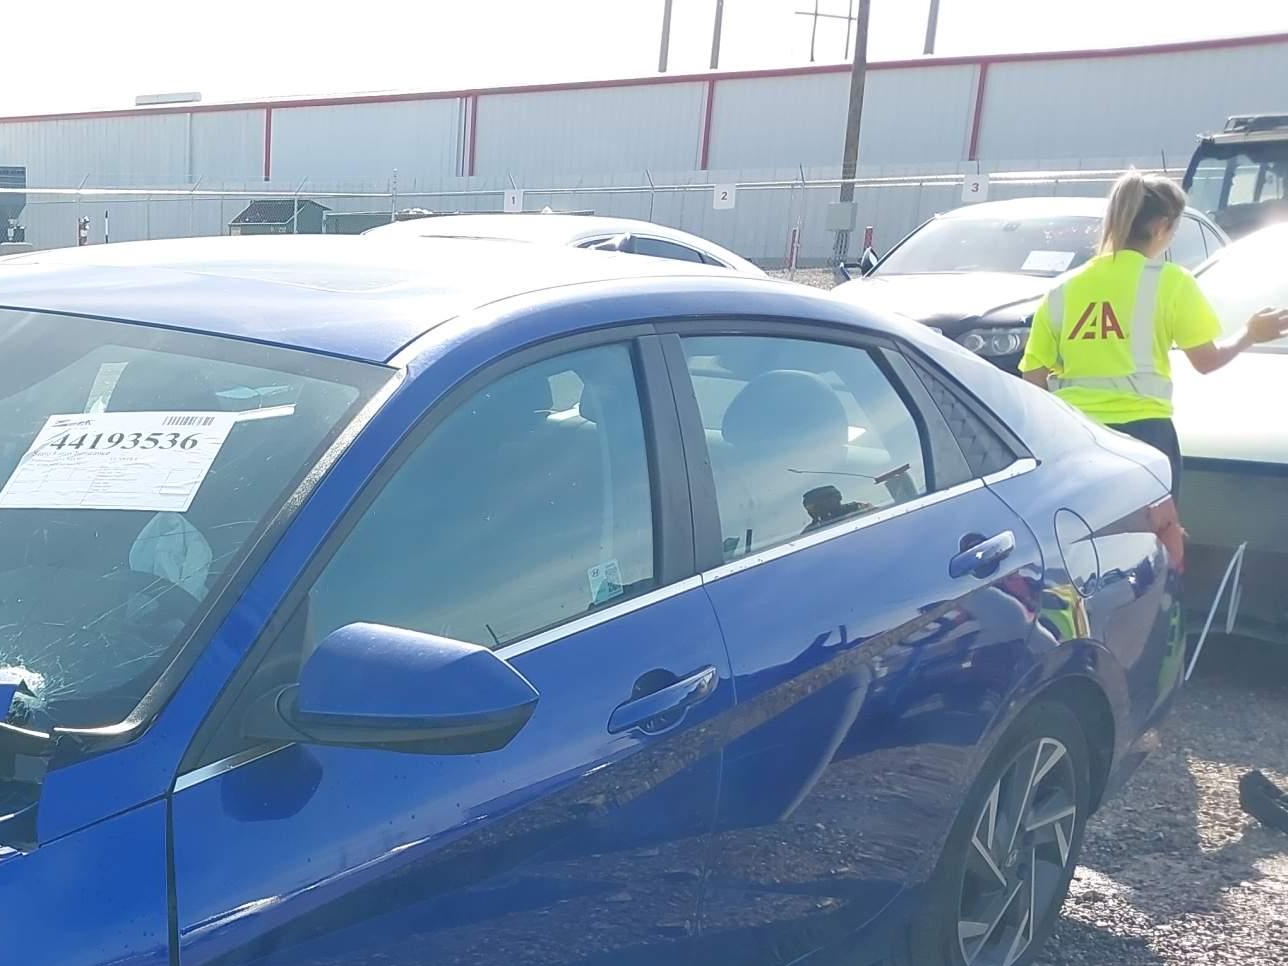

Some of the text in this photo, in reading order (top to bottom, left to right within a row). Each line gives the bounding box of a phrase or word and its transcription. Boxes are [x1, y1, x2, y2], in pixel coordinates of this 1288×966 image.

[971, 182, 980, 193] 3
[720, 191, 729, 201] 2
[49, 431, 203, 451] 44193536
